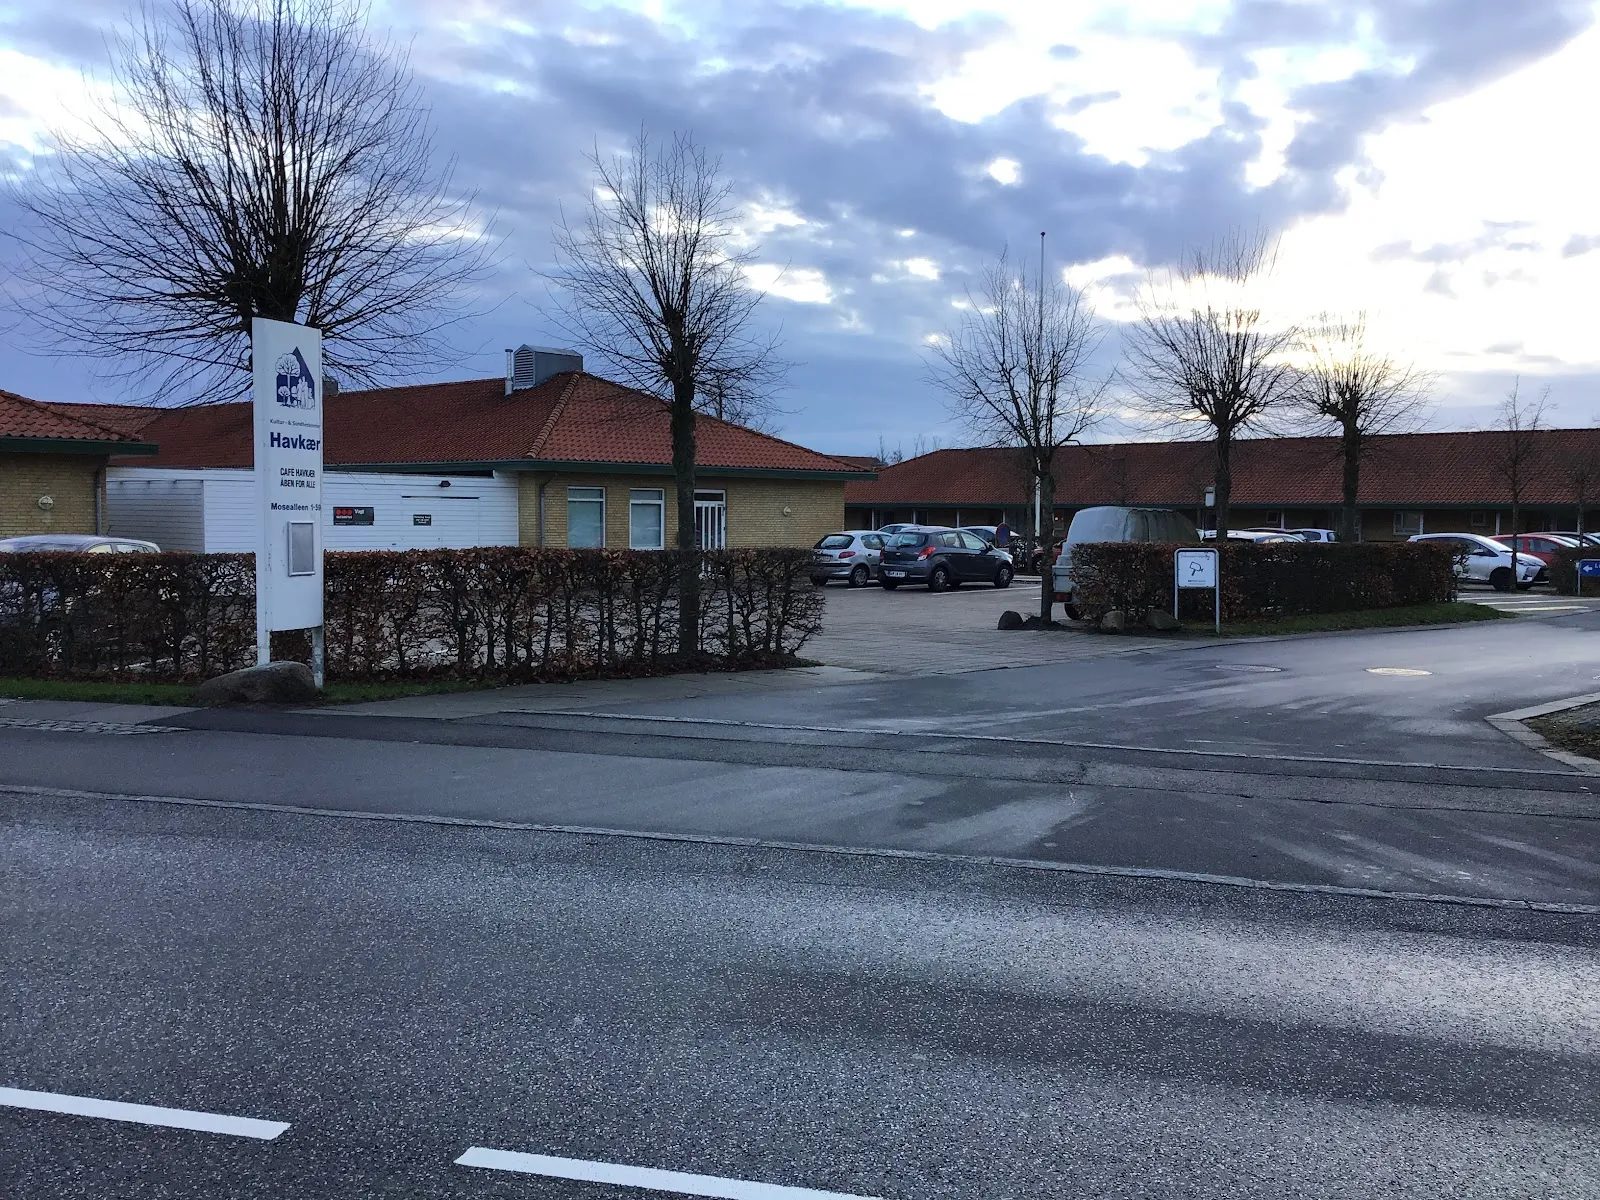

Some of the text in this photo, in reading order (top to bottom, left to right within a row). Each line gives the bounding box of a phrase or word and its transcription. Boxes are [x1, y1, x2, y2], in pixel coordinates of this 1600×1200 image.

[270, 432, 320, 451] Havkær
[295, 469, 315, 478] HAVKÆR
[280, 477, 295, 488] ÅBEN
[295, 480, 305, 488] FOR
[271, 502, 309, 511] Mosealleen
